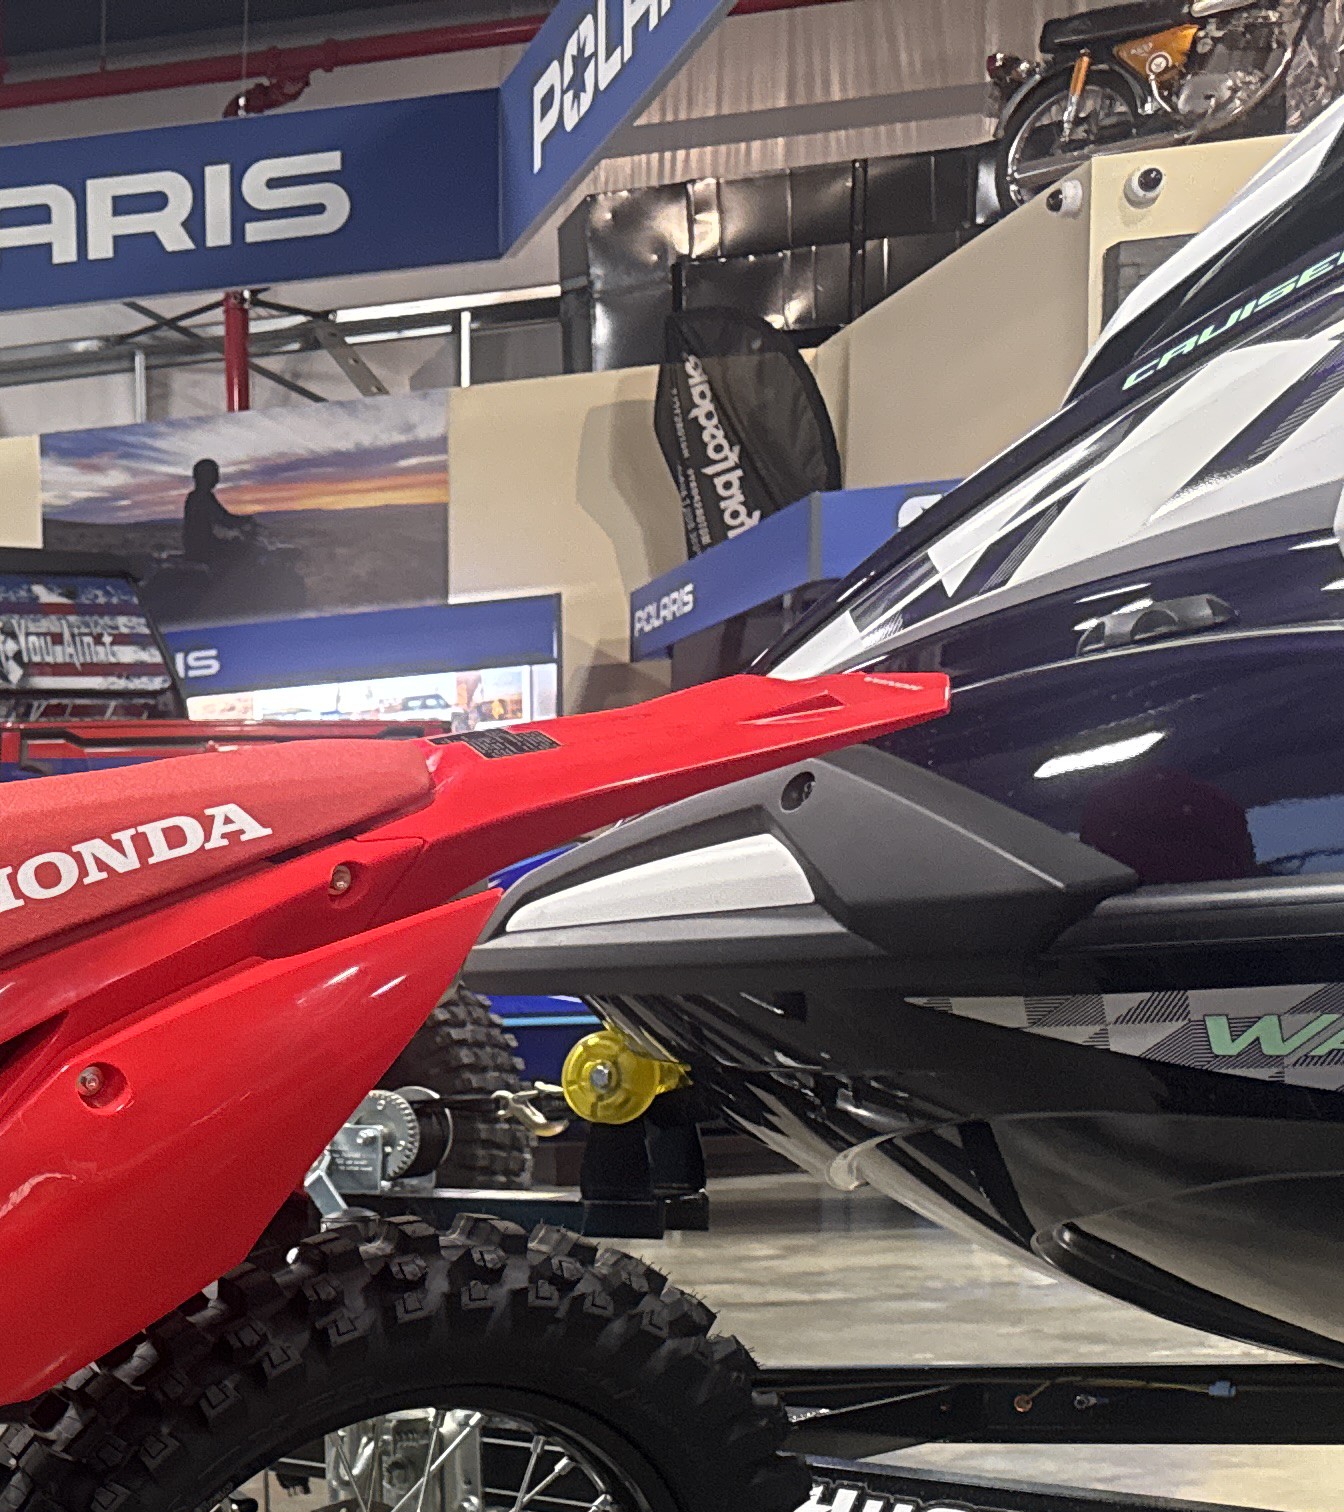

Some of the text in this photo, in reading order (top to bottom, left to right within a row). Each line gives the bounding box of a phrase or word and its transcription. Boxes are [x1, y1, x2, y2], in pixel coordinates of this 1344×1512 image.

[533, 0, 671, 174] POLA
[1122, 251, 1344, 390] CRUISE
[11, 618, 54, 663] You
[634, 582, 695, 637] POLARIS
